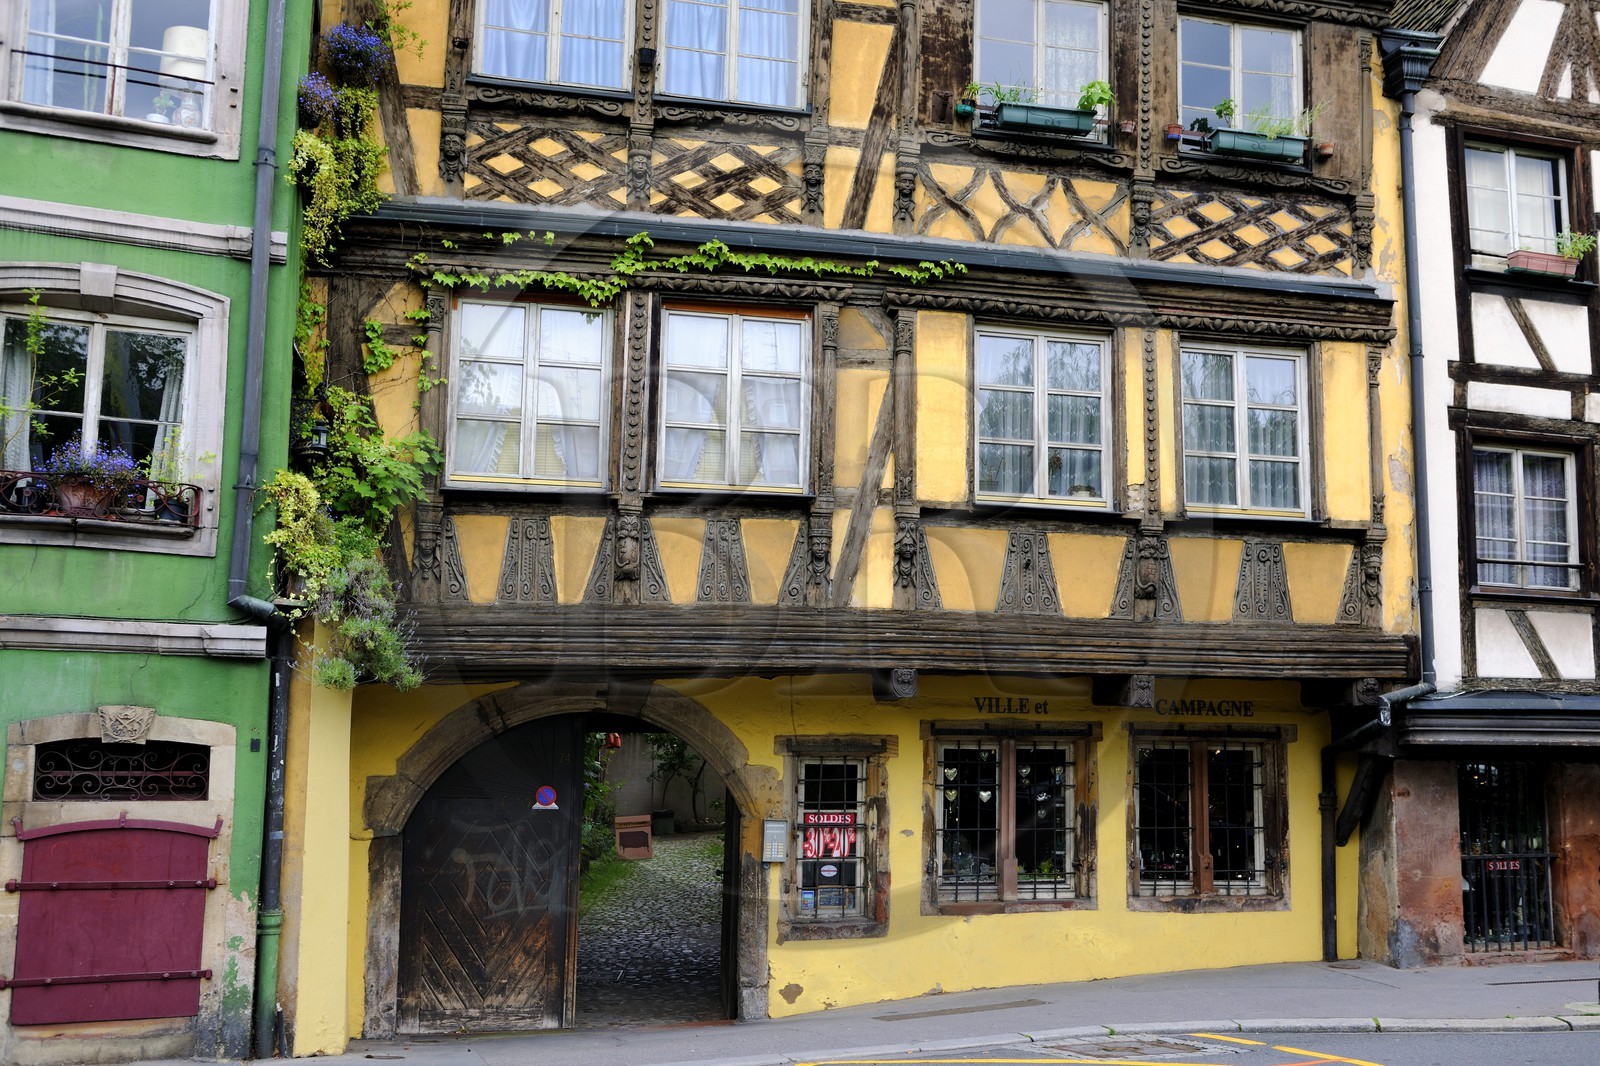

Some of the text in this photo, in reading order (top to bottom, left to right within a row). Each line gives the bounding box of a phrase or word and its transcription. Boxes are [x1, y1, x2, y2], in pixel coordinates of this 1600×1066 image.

[974, 696, 1254, 717] VILLE et CAMPAGNE
[559, 752, 570, 763] 24
[809, 814, 851, 823] SOLDES
